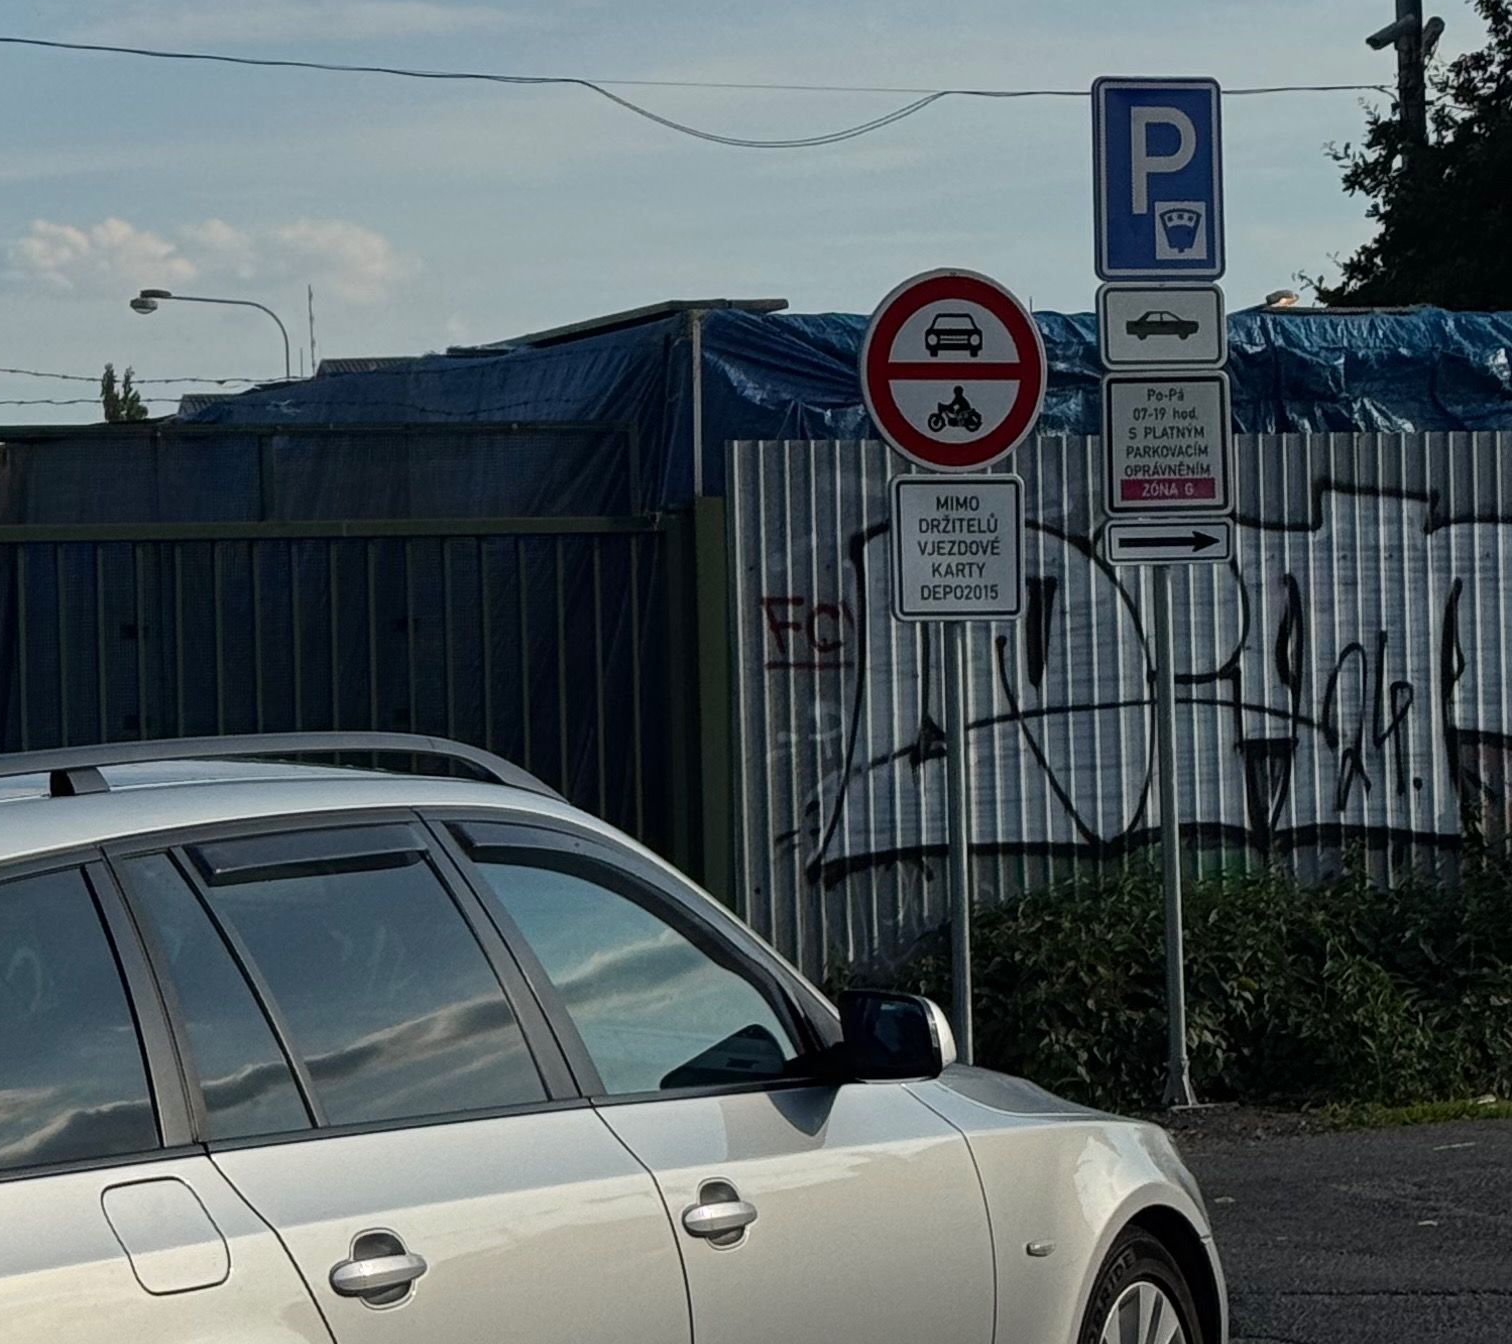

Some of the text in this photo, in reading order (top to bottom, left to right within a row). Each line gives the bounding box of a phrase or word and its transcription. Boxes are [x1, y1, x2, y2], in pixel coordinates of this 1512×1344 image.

[1131, 105, 1197, 215] P
[1132, 407, 1167, 421] 07-19
[1128, 423, 1205, 440] S PLATNÝM
[1126, 441, 1209, 459] PARKOVACÍM
[1141, 480, 1179, 497] ZÓNA
[935, 495, 980, 512] MIMO
[918, 512, 998, 534] DRŽITELŮ
[917, 536, 1001, 556] VJEZDOVÉ
[931, 562, 986, 578] KARTY
[920, 584, 999, 601] DEPO2015
